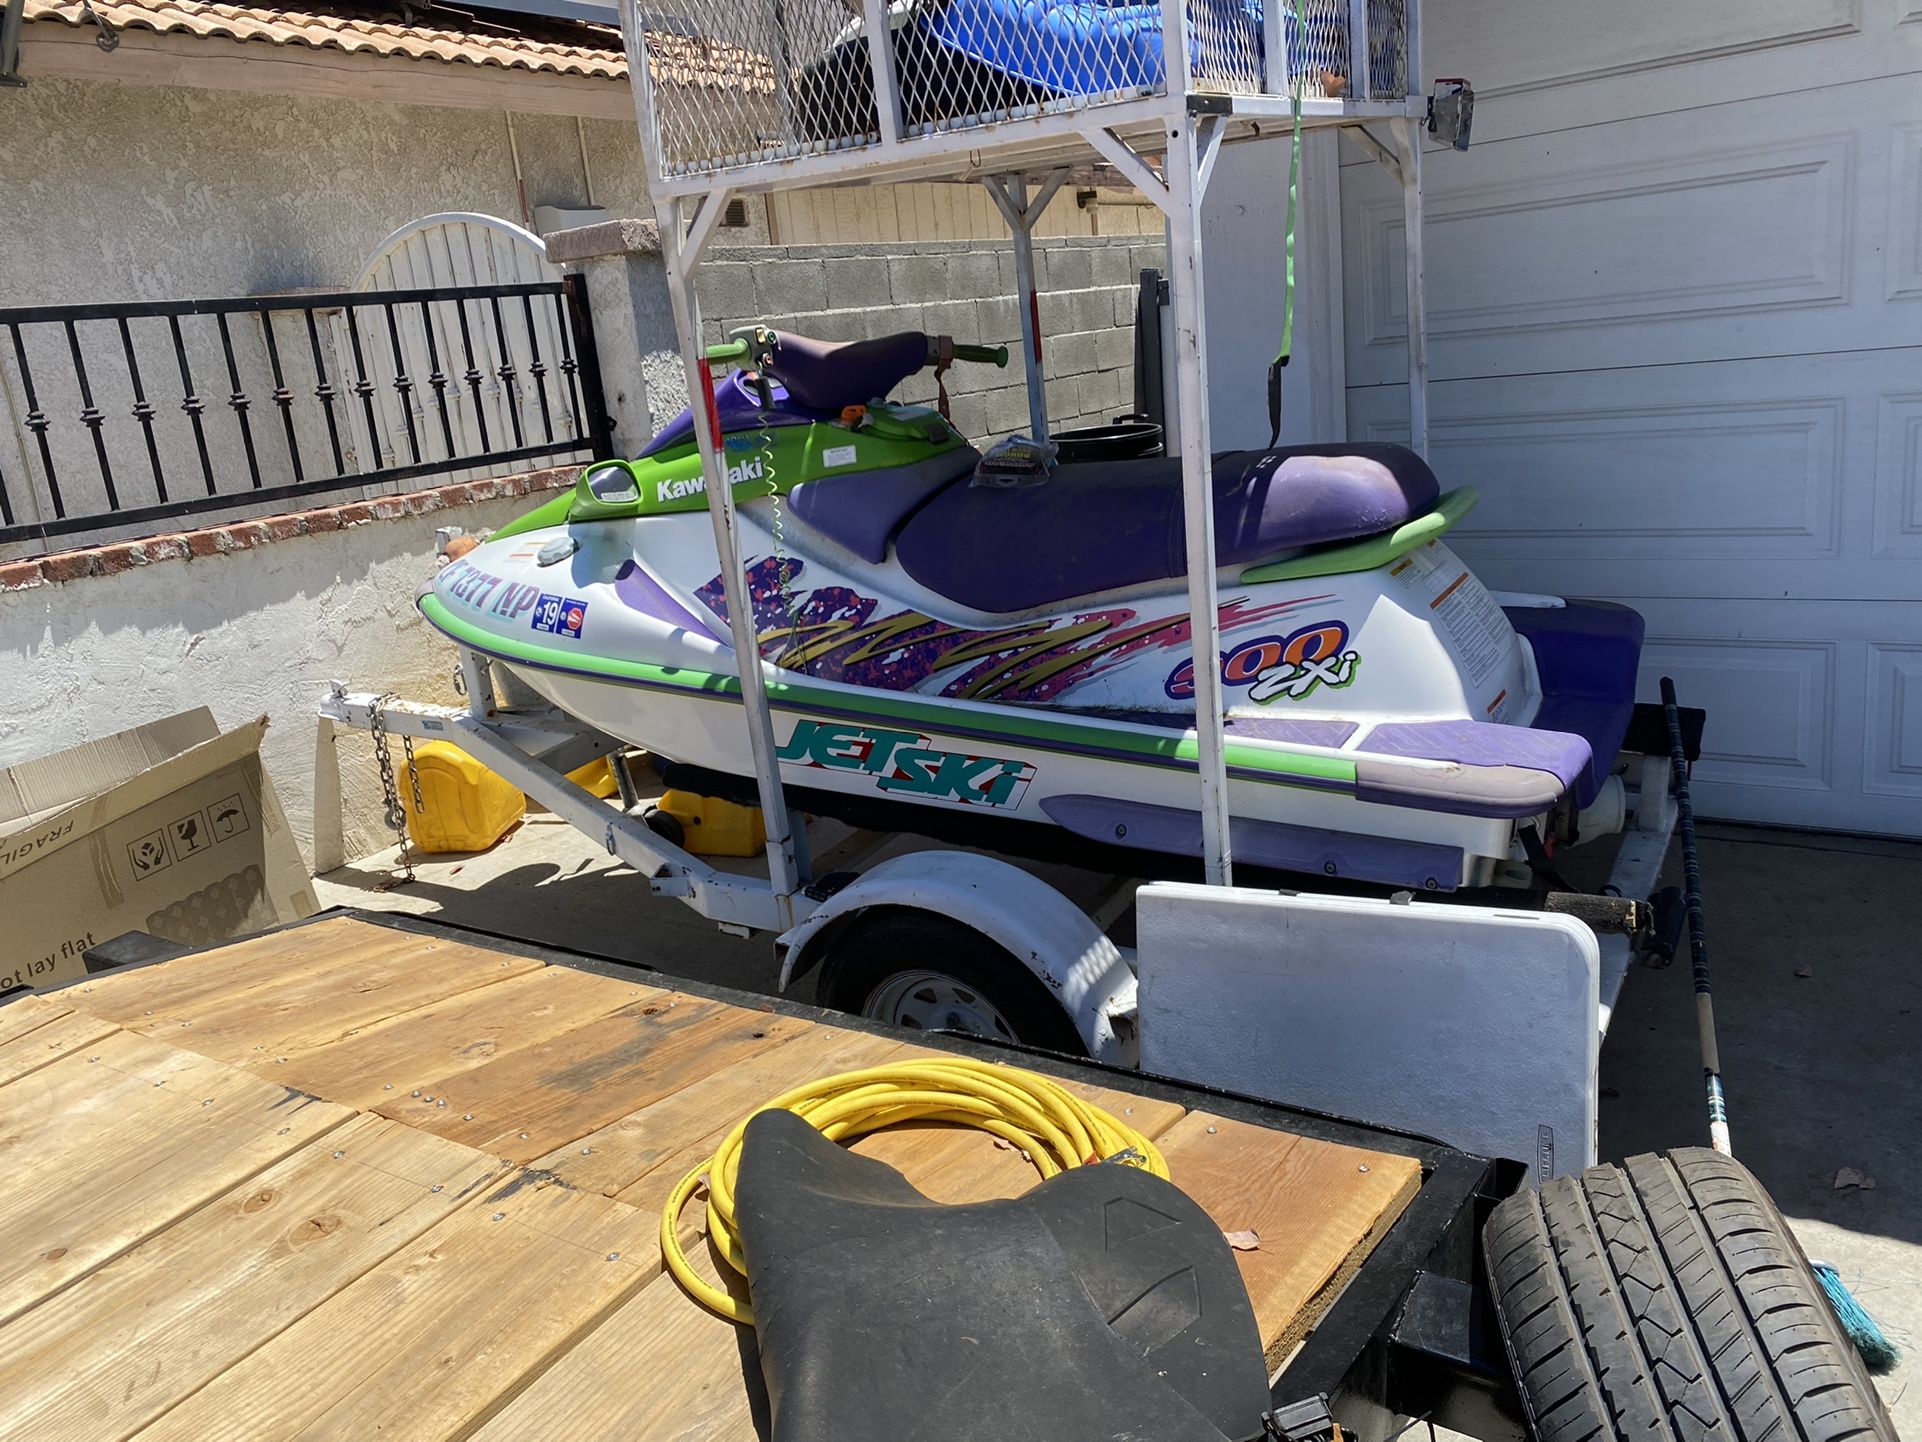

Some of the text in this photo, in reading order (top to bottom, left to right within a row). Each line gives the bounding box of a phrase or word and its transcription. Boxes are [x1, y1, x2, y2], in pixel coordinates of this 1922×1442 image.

[657, 456, 764, 502] Kawaki
[491, 581, 541, 619] NP
[542, 601, 559, 625] 19
[27, 953, 56, 978] lay
[60, 931, 96, 960] flat
